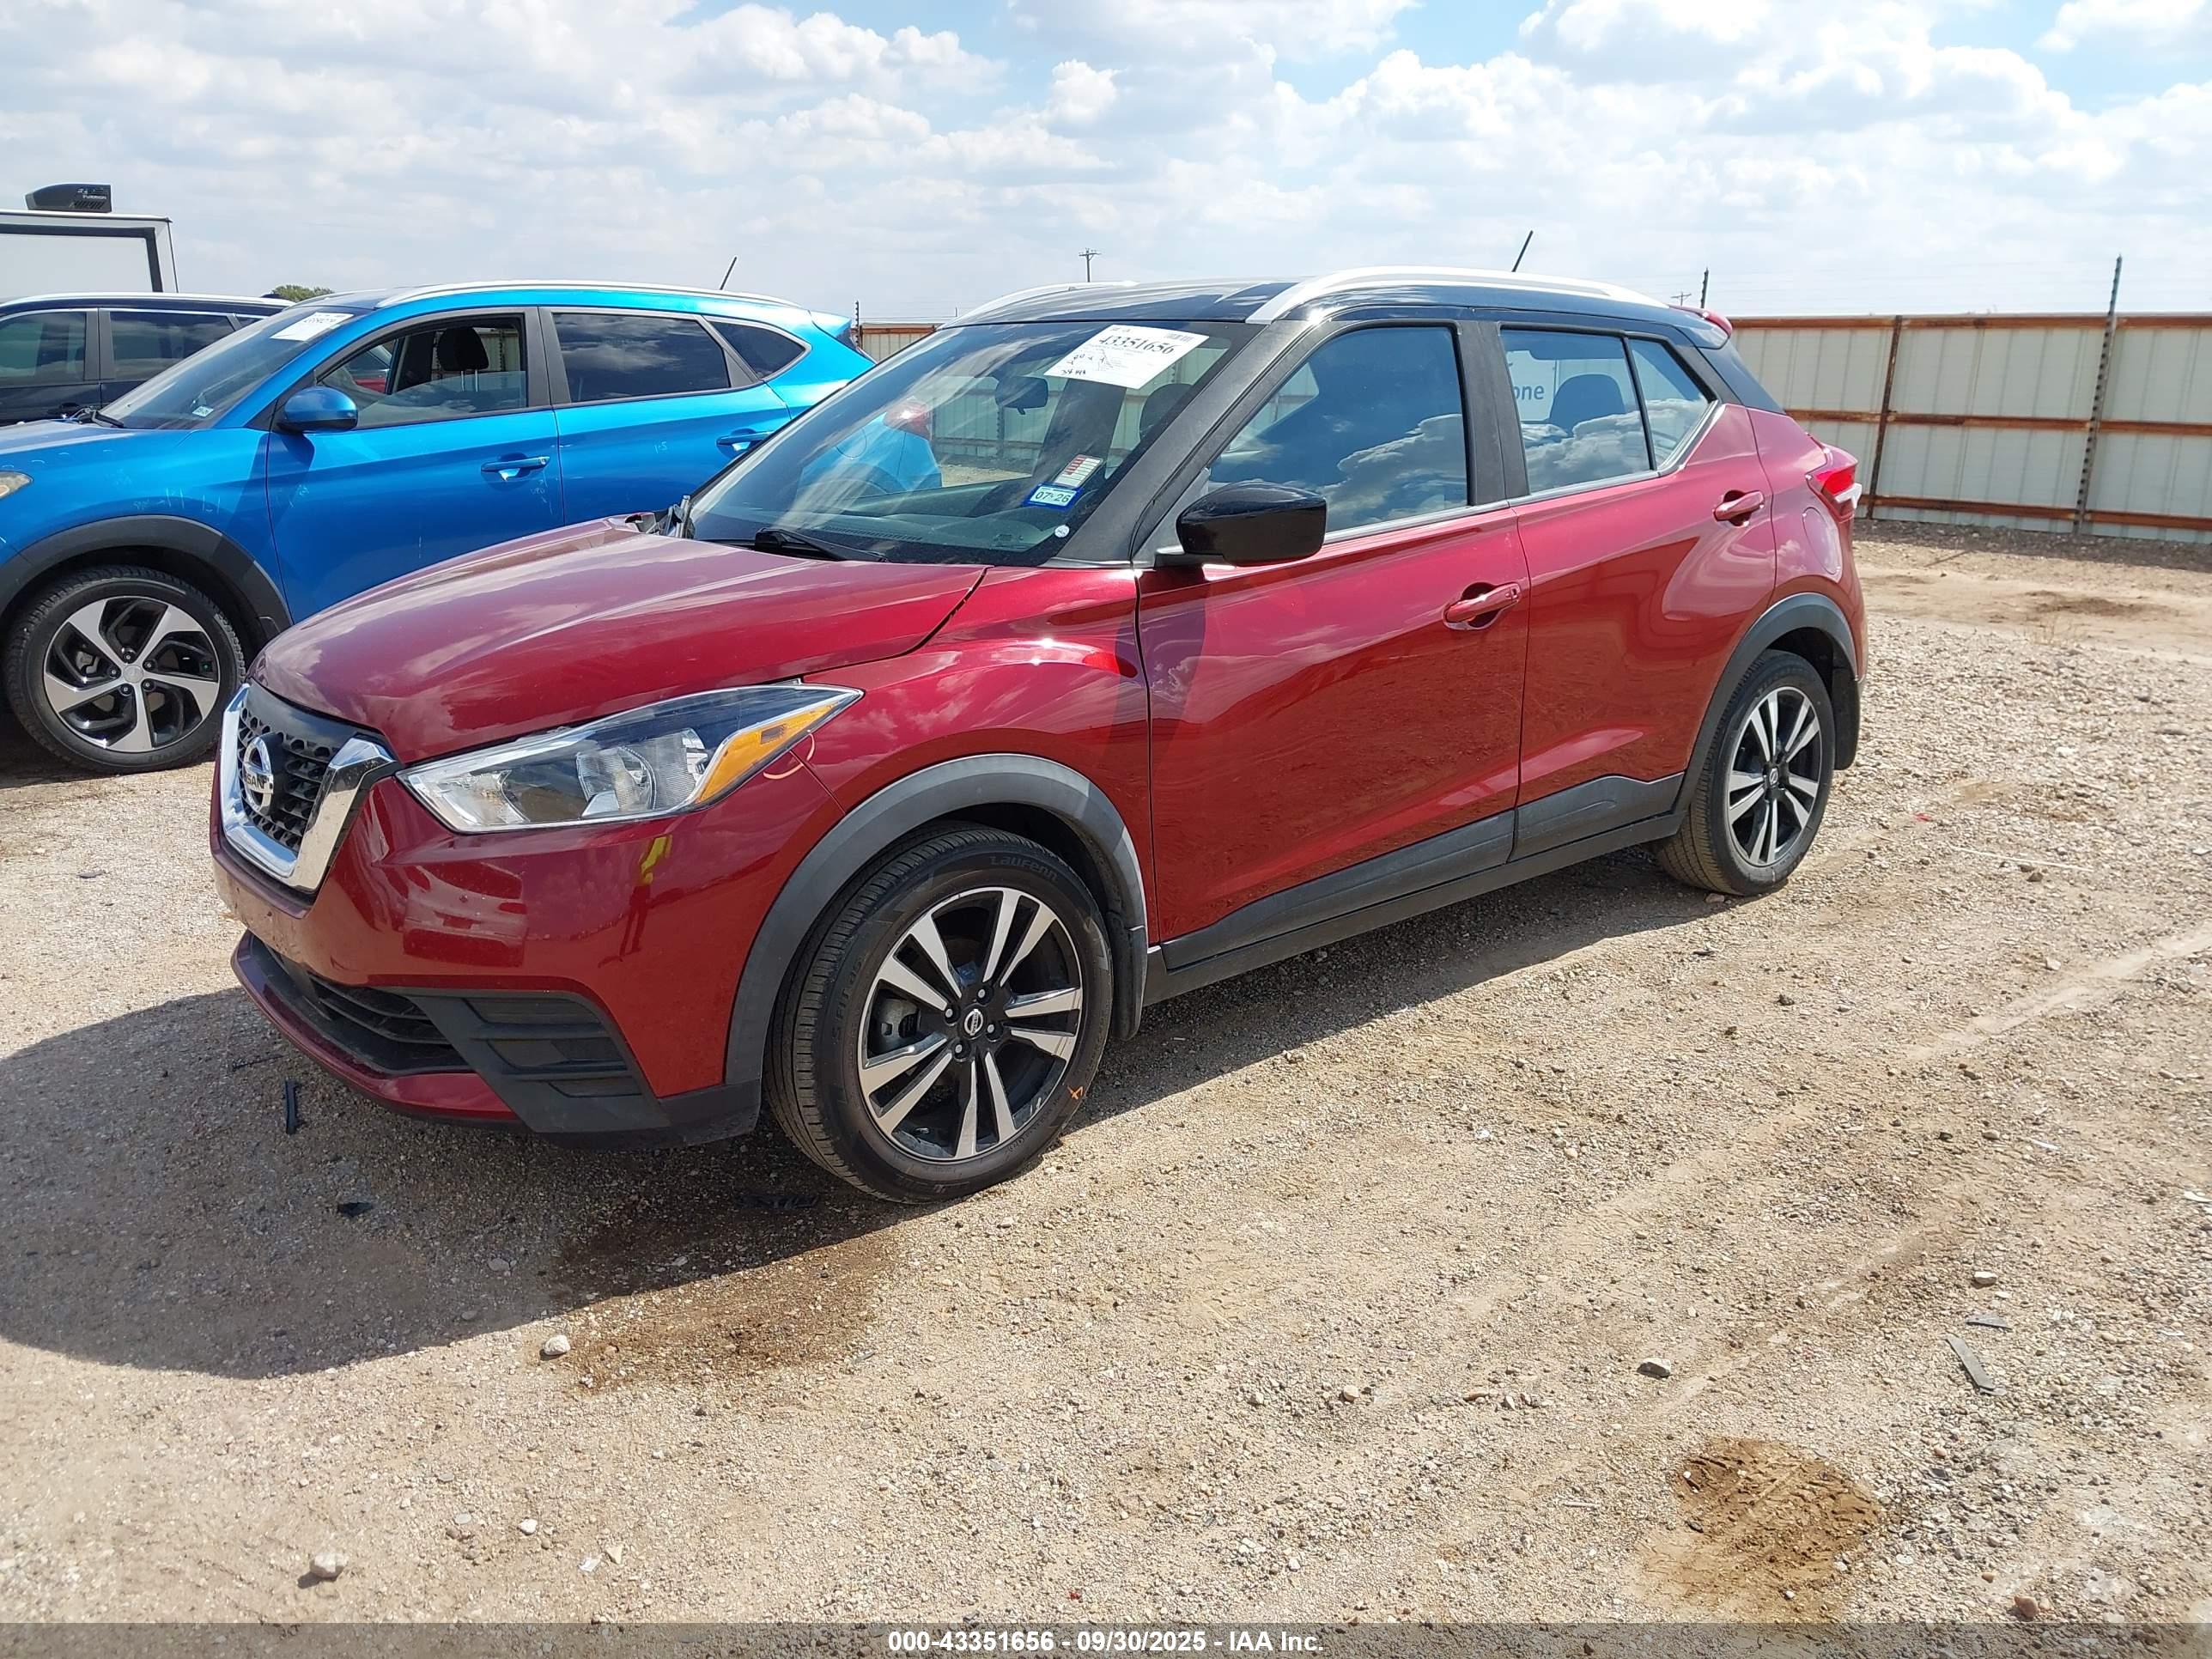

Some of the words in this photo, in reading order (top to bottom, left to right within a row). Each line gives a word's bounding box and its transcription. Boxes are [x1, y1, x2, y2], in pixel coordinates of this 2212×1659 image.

[1098, 335, 1175, 354] 43351656
[1035, 490, 1051, 501] 07
[1053, 493, 1073, 504] 26
